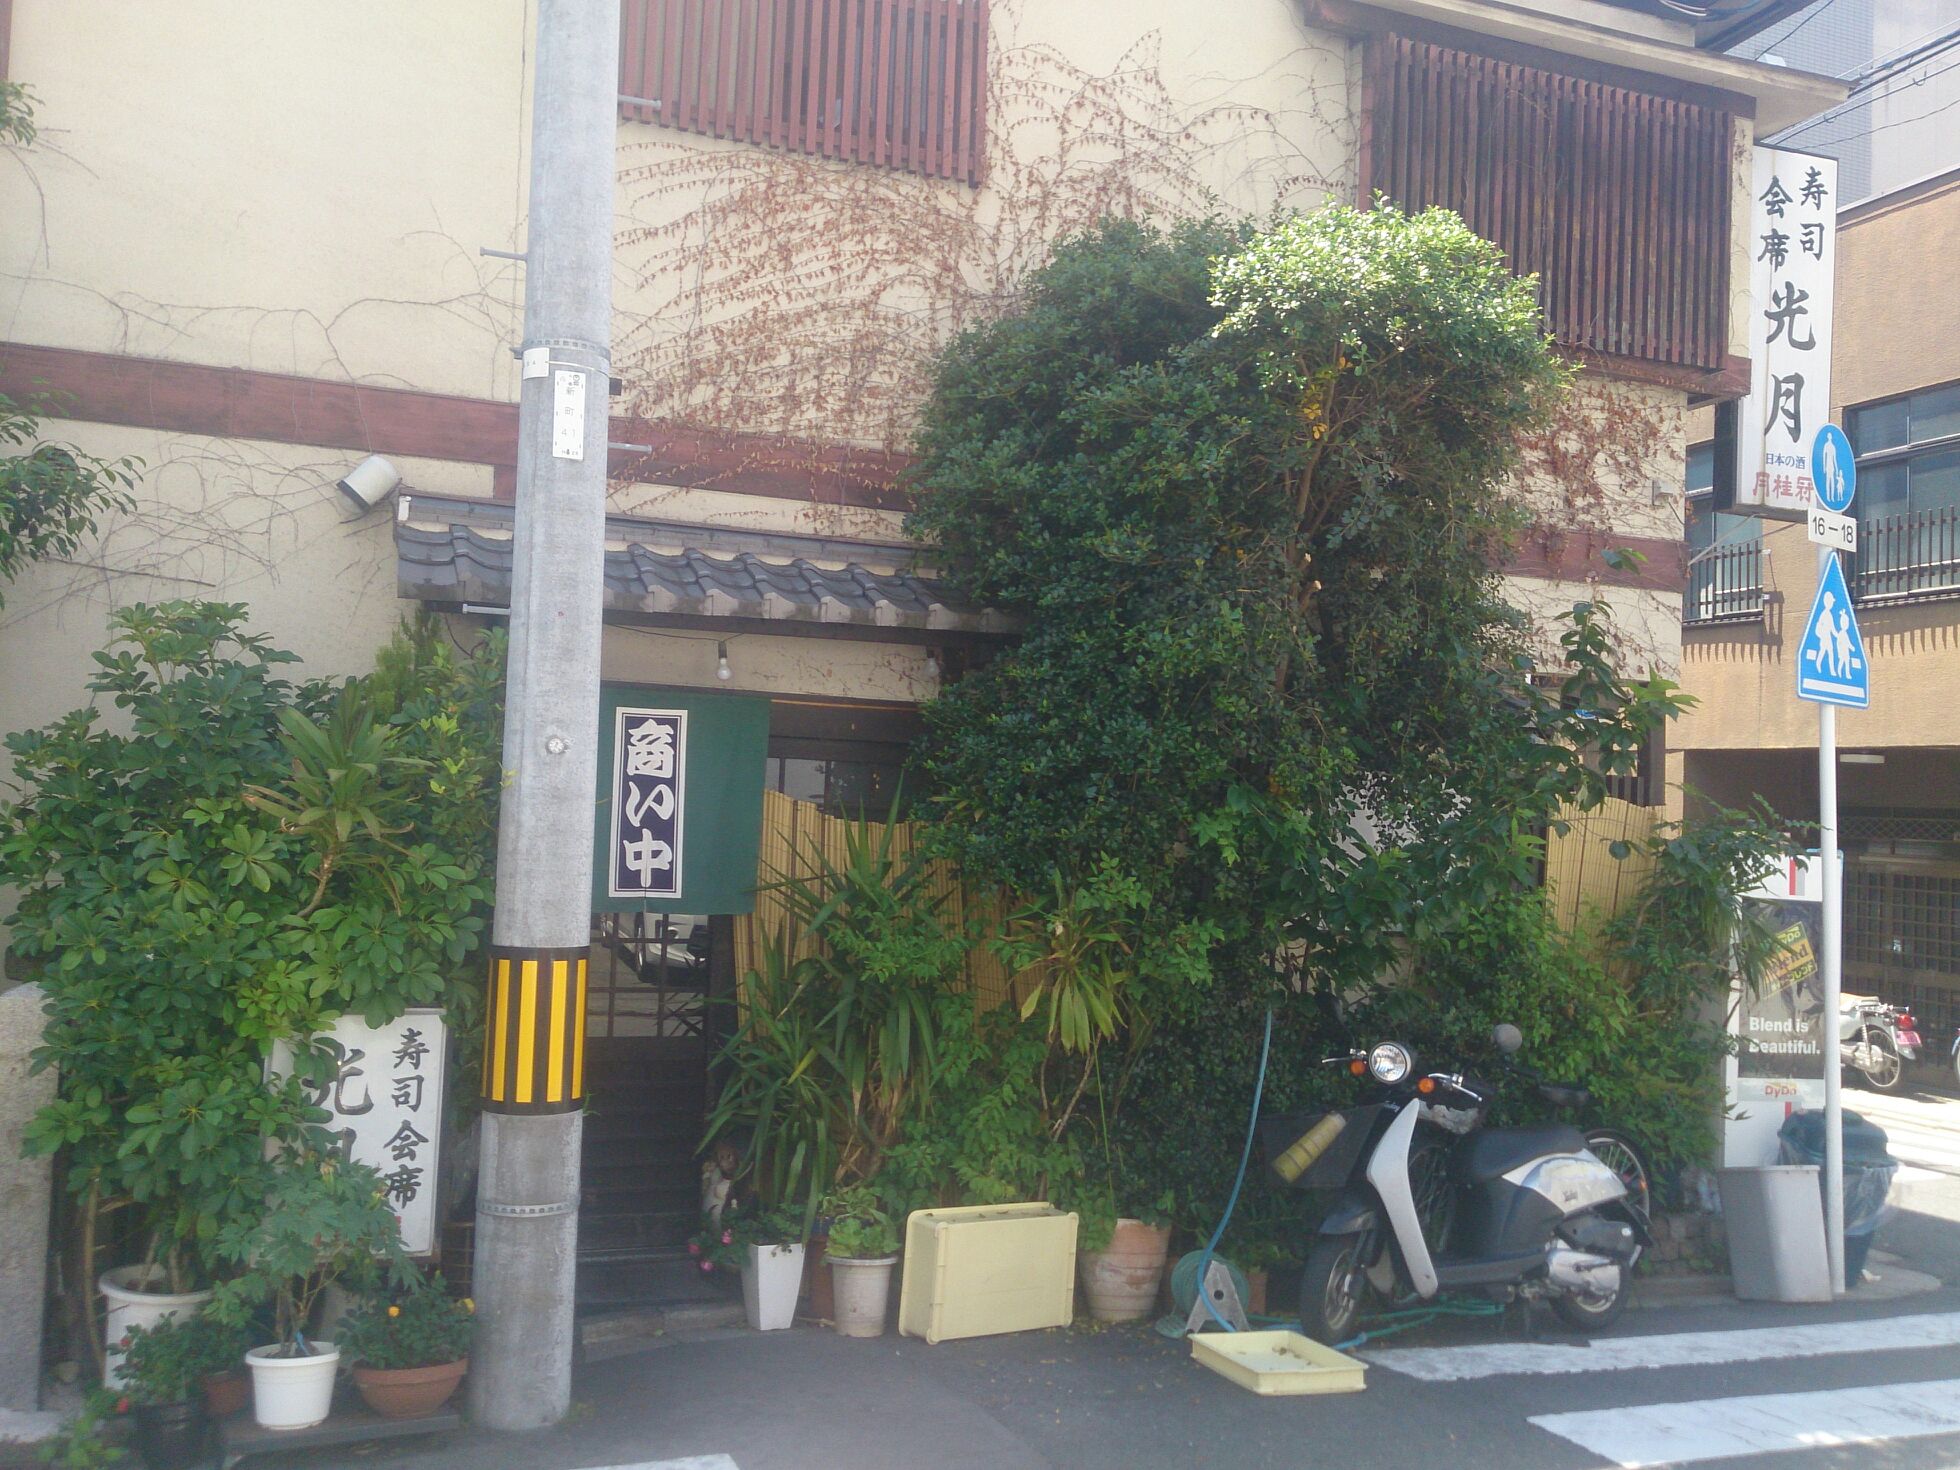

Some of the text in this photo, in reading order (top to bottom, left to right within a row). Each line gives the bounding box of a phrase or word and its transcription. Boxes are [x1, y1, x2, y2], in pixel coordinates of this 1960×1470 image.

[1758, 175, 1793, 272] 会席
[1799, 166, 1828, 261] 寿司
[1764, 281, 1816, 443] 光月
[1752, 472, 1814, 502] 月桂冠
[1766, 453, 1806, 469] 日本の酒
[622, 719, 674, 887] 商い中
[1748, 1039, 1820, 1054] Beautiful.
[1749, 1017, 1809, 1032] Blend is
[383, 1027, 429, 1209] 寿司会席
[1765, 1085, 1797, 1098] DyDo
